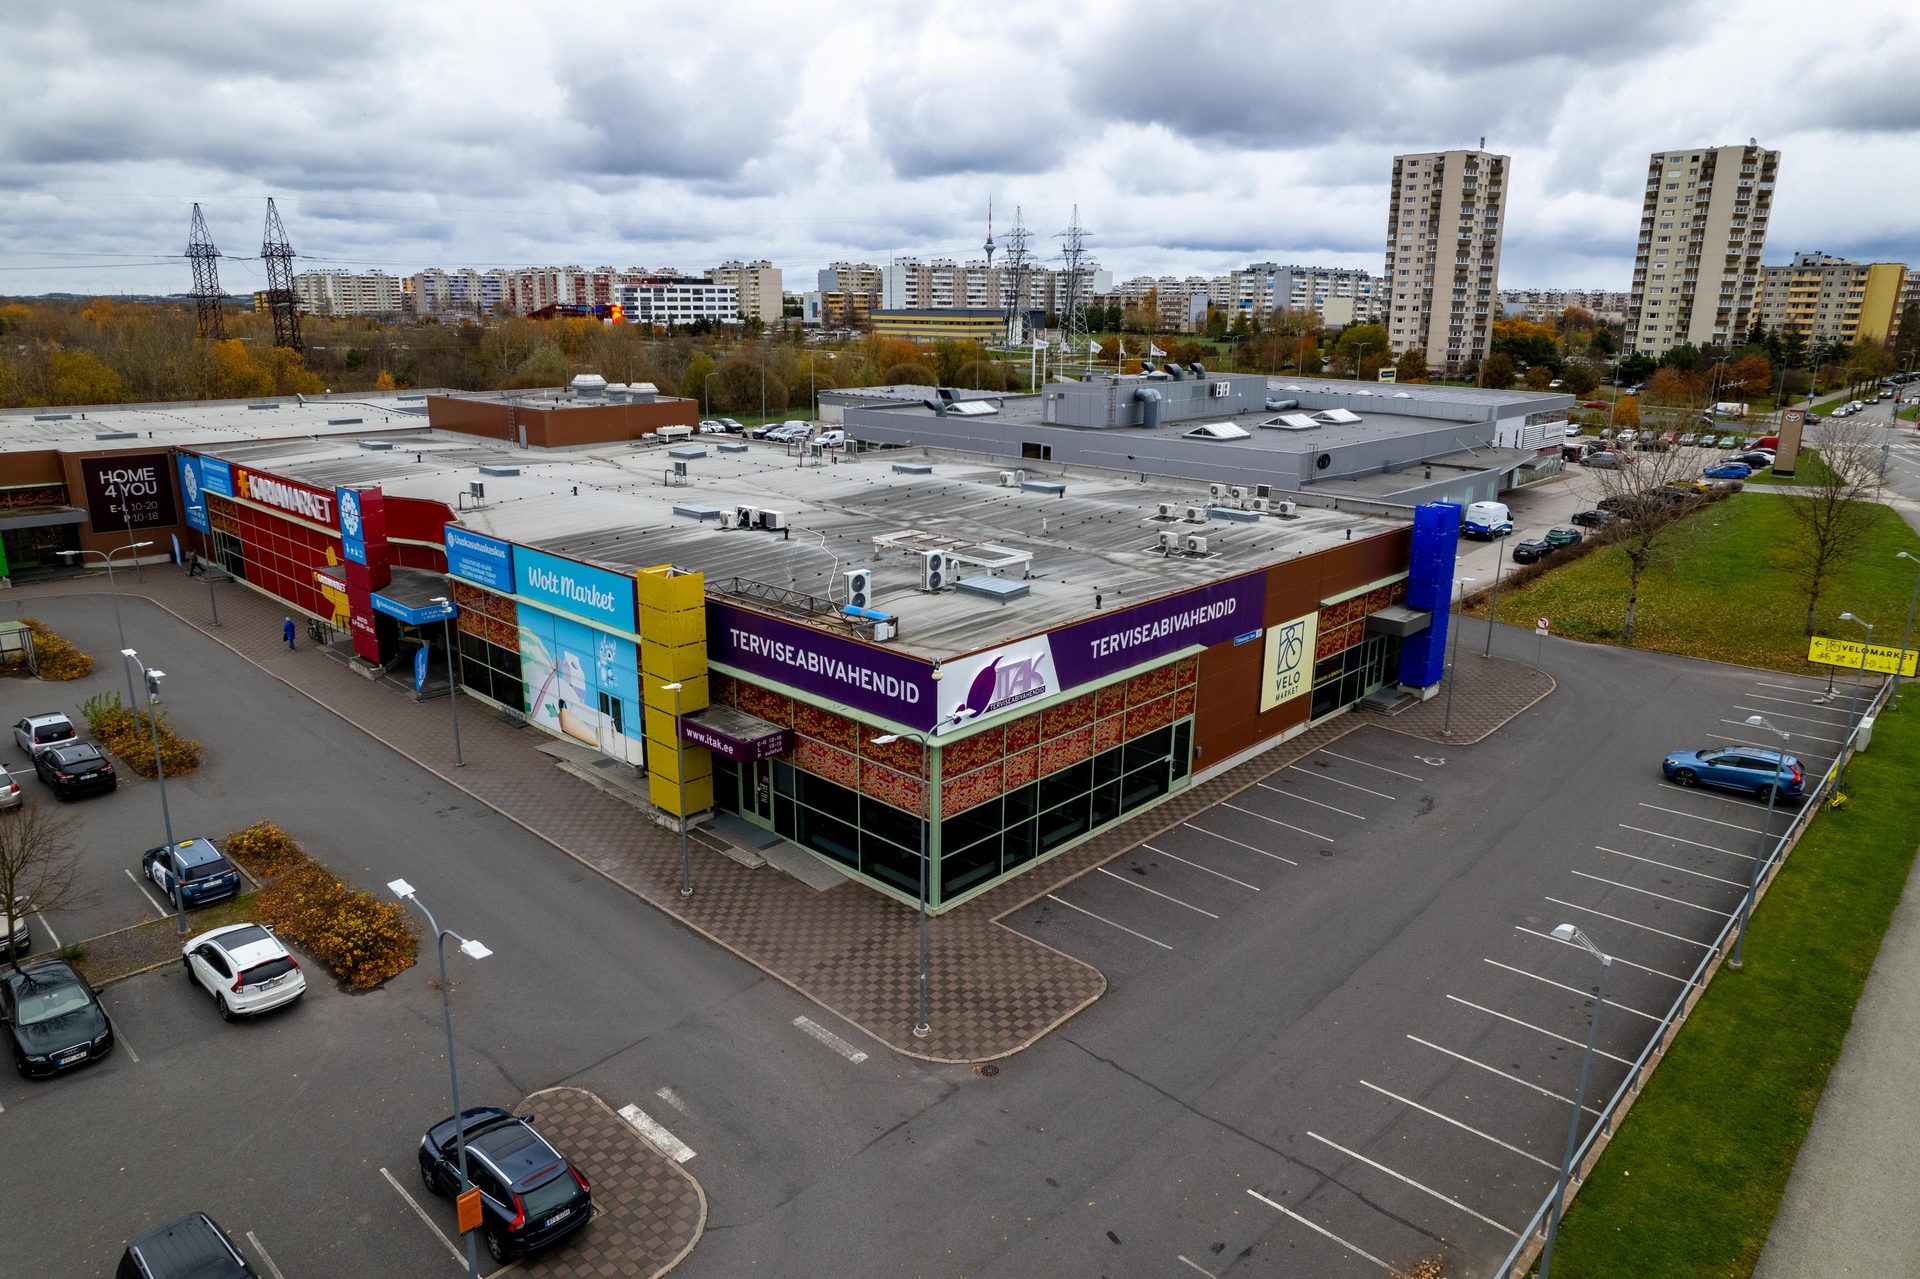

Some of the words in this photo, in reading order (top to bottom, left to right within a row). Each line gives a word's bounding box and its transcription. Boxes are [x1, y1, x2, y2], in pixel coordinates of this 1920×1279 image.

[100, 467, 156, 484] HOME
[105, 485, 117, 498] 4
[120, 481, 157, 497] YOU
[131, 501, 158, 511] 10-20
[133, 512, 159, 522] 10-18
[528, 566, 560, 594] Wolt
[561, 575, 615, 613] Market
[1091, 598, 1236, 659] TERVISEABIVAHENDID
[1842, 645, 1915, 661] VELOMARKET
[730, 628, 920, 704] TERVISEABIVAHENDID
[1276, 671, 1300, 691] VELO
[990, 686, 1045, 711] TERVISEABIVAHENDID
[1275, 685, 1299, 701] MARKET
[686, 728, 734, 755] www.itak.ee
